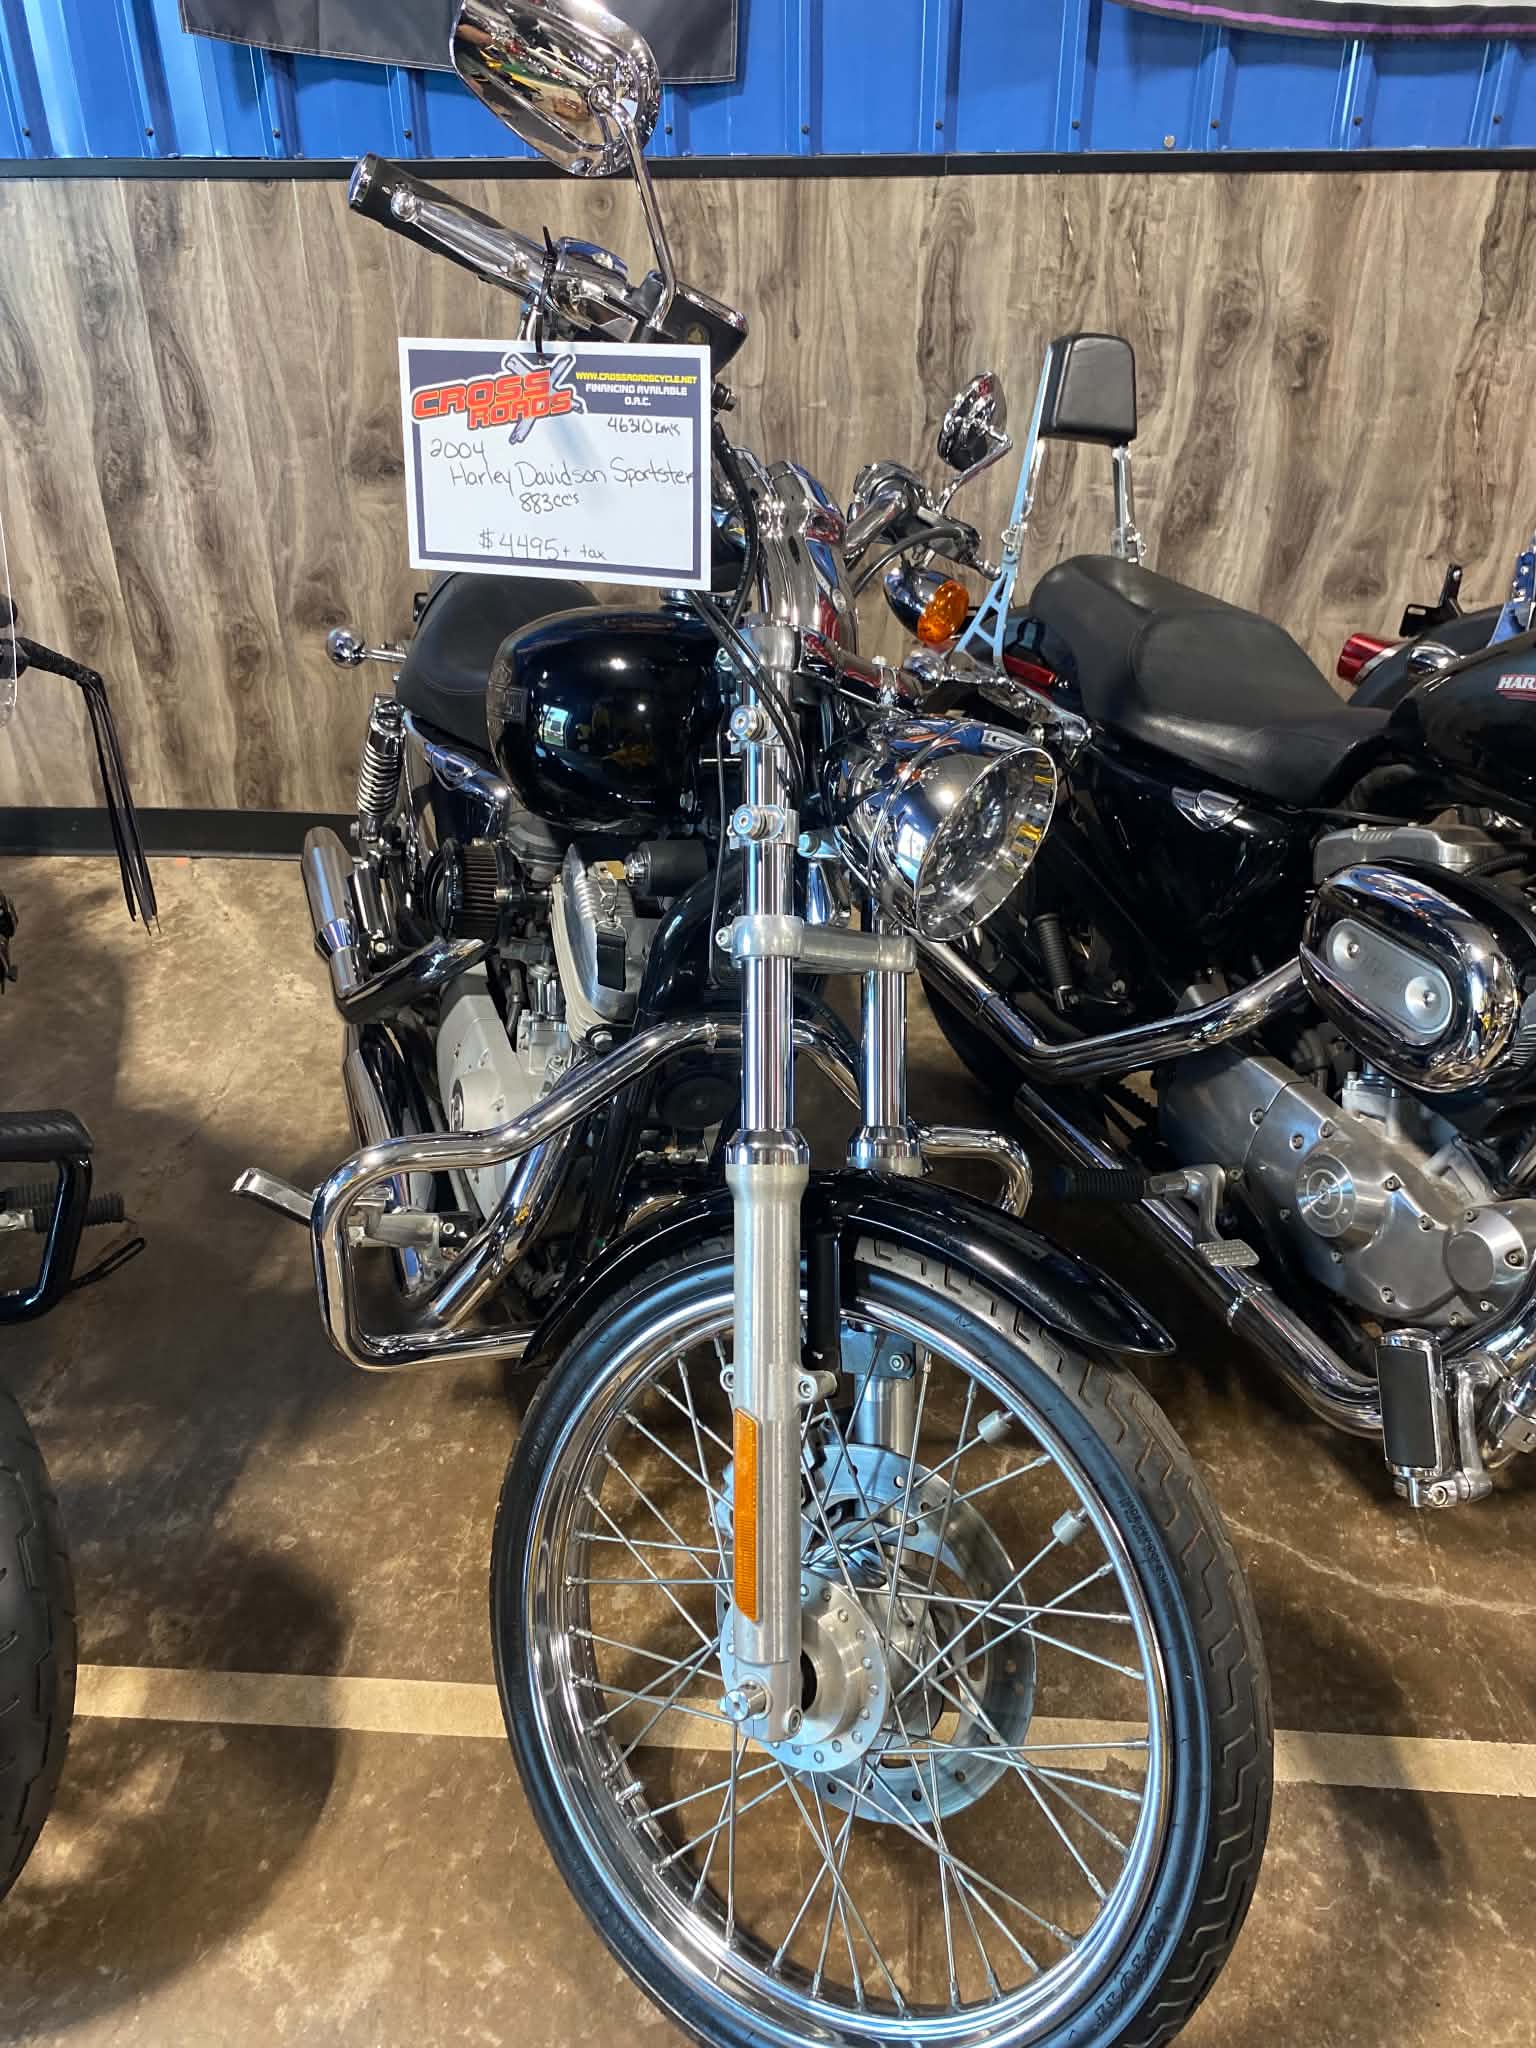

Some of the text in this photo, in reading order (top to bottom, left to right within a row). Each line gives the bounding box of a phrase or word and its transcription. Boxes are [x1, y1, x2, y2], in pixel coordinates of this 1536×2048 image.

[413, 369, 550, 418] CROSS
[585, 383, 688, 396] FINANCING AVAILABLE
[468, 390, 572, 429] ROADS
[430, 438, 487, 463] 2004
[449, 457, 696, 496] Harley Davidson Sportster
[579, 543, 608, 561] tax
